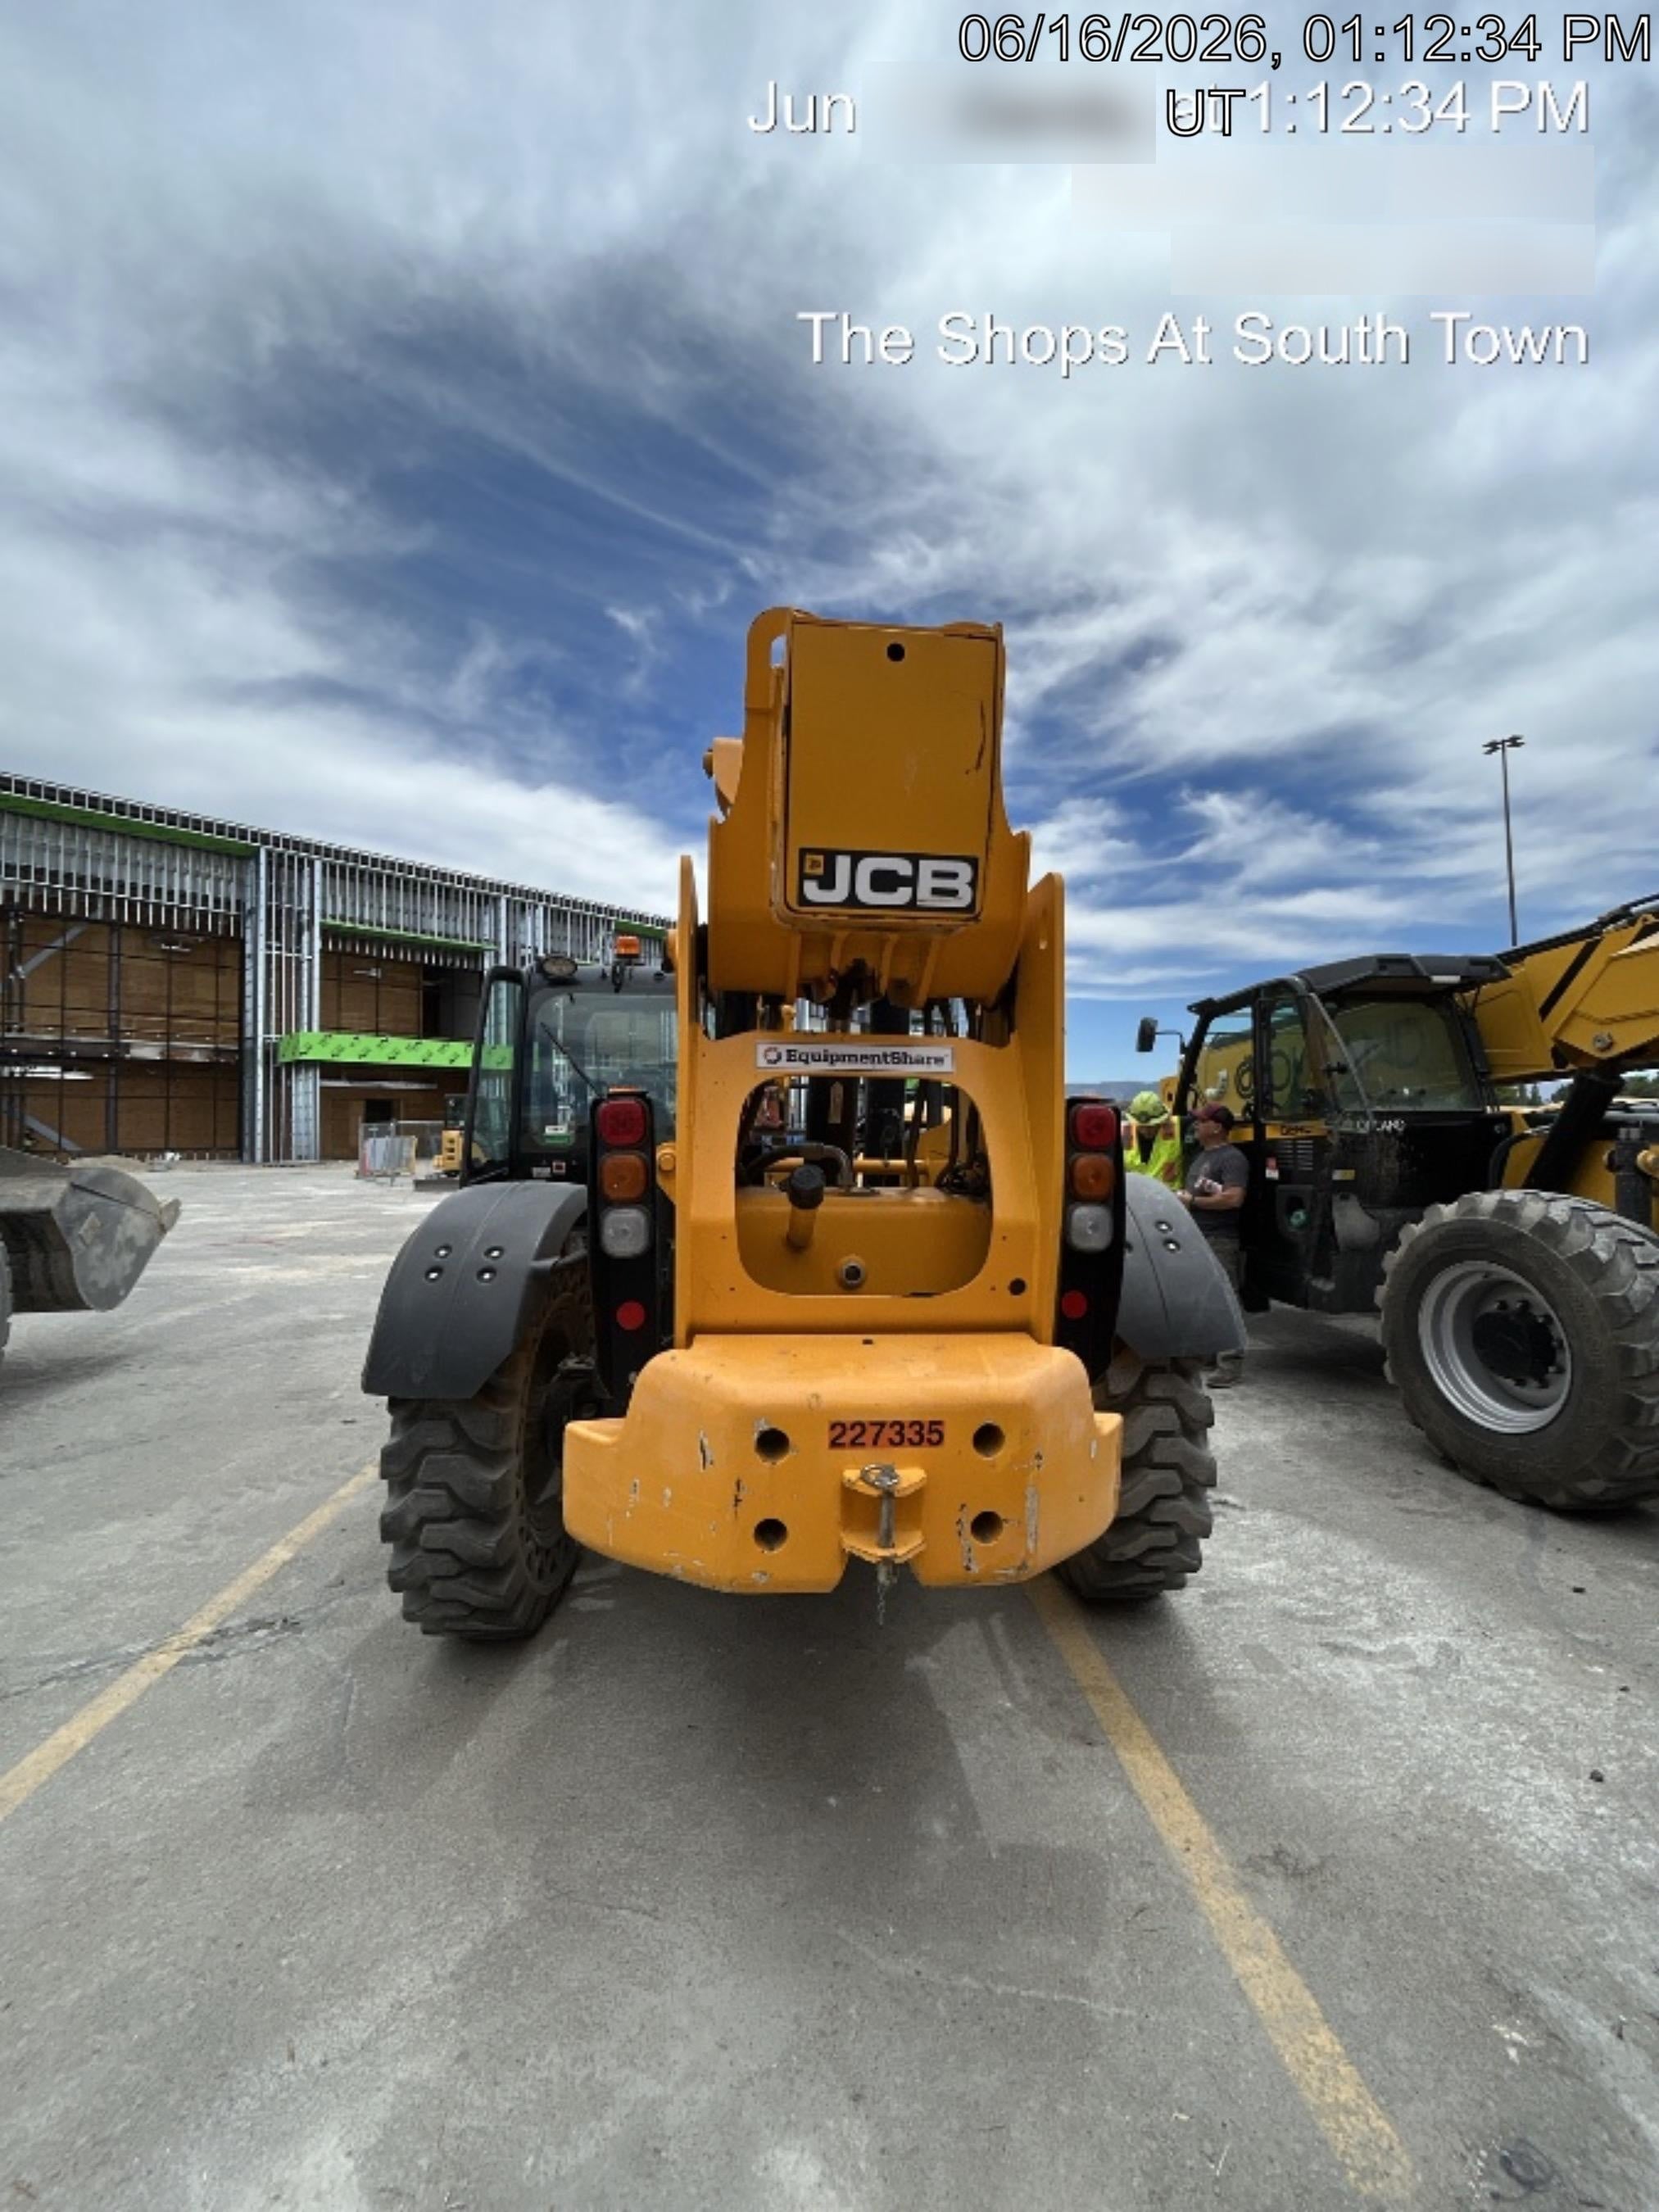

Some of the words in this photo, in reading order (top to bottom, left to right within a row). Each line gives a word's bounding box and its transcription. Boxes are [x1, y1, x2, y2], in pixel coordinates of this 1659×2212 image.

[803, 854, 972, 908] JCB
[785, 1048, 945, 1067] EquipmentShare
[829, 1420, 945, 1448] 227335
